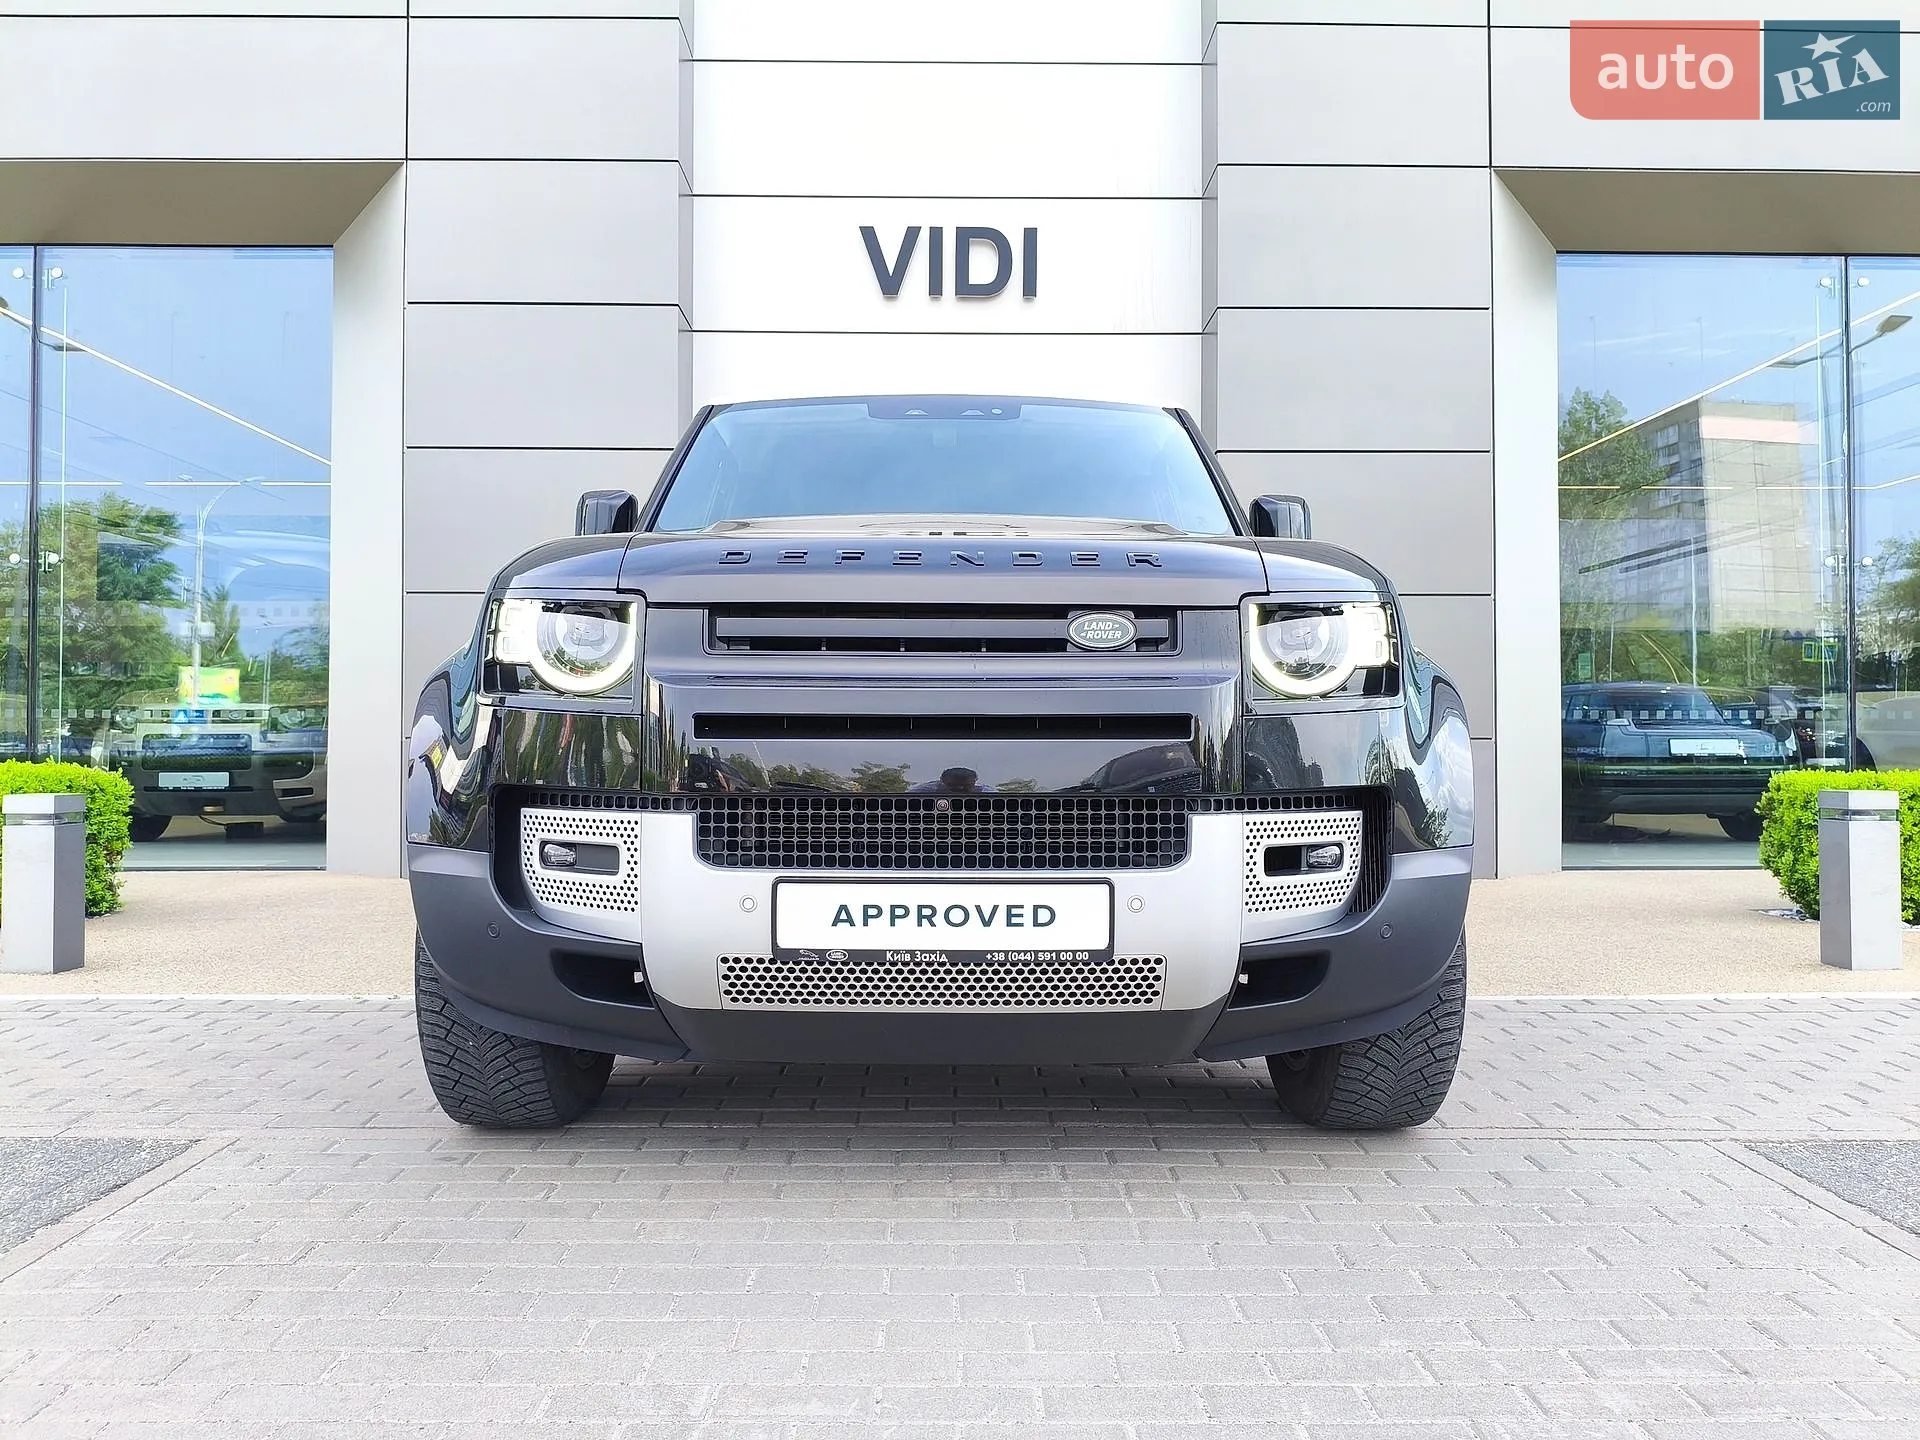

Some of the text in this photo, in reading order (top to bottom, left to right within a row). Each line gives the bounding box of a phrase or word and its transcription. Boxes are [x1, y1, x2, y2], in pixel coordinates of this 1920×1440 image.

[858, 226, 1037, 298] VIDI
[718, 549, 1163, 568] DEFENDER
[1083, 621, 1113, 631] LAND
[1086, 630, 1122, 639] ROVER
[831, 904, 1057, 928] APPROVED
[886, 950, 948, 963] Київ Захід
[985, 951, 1089, 962] +38 (044) 591 00 00
